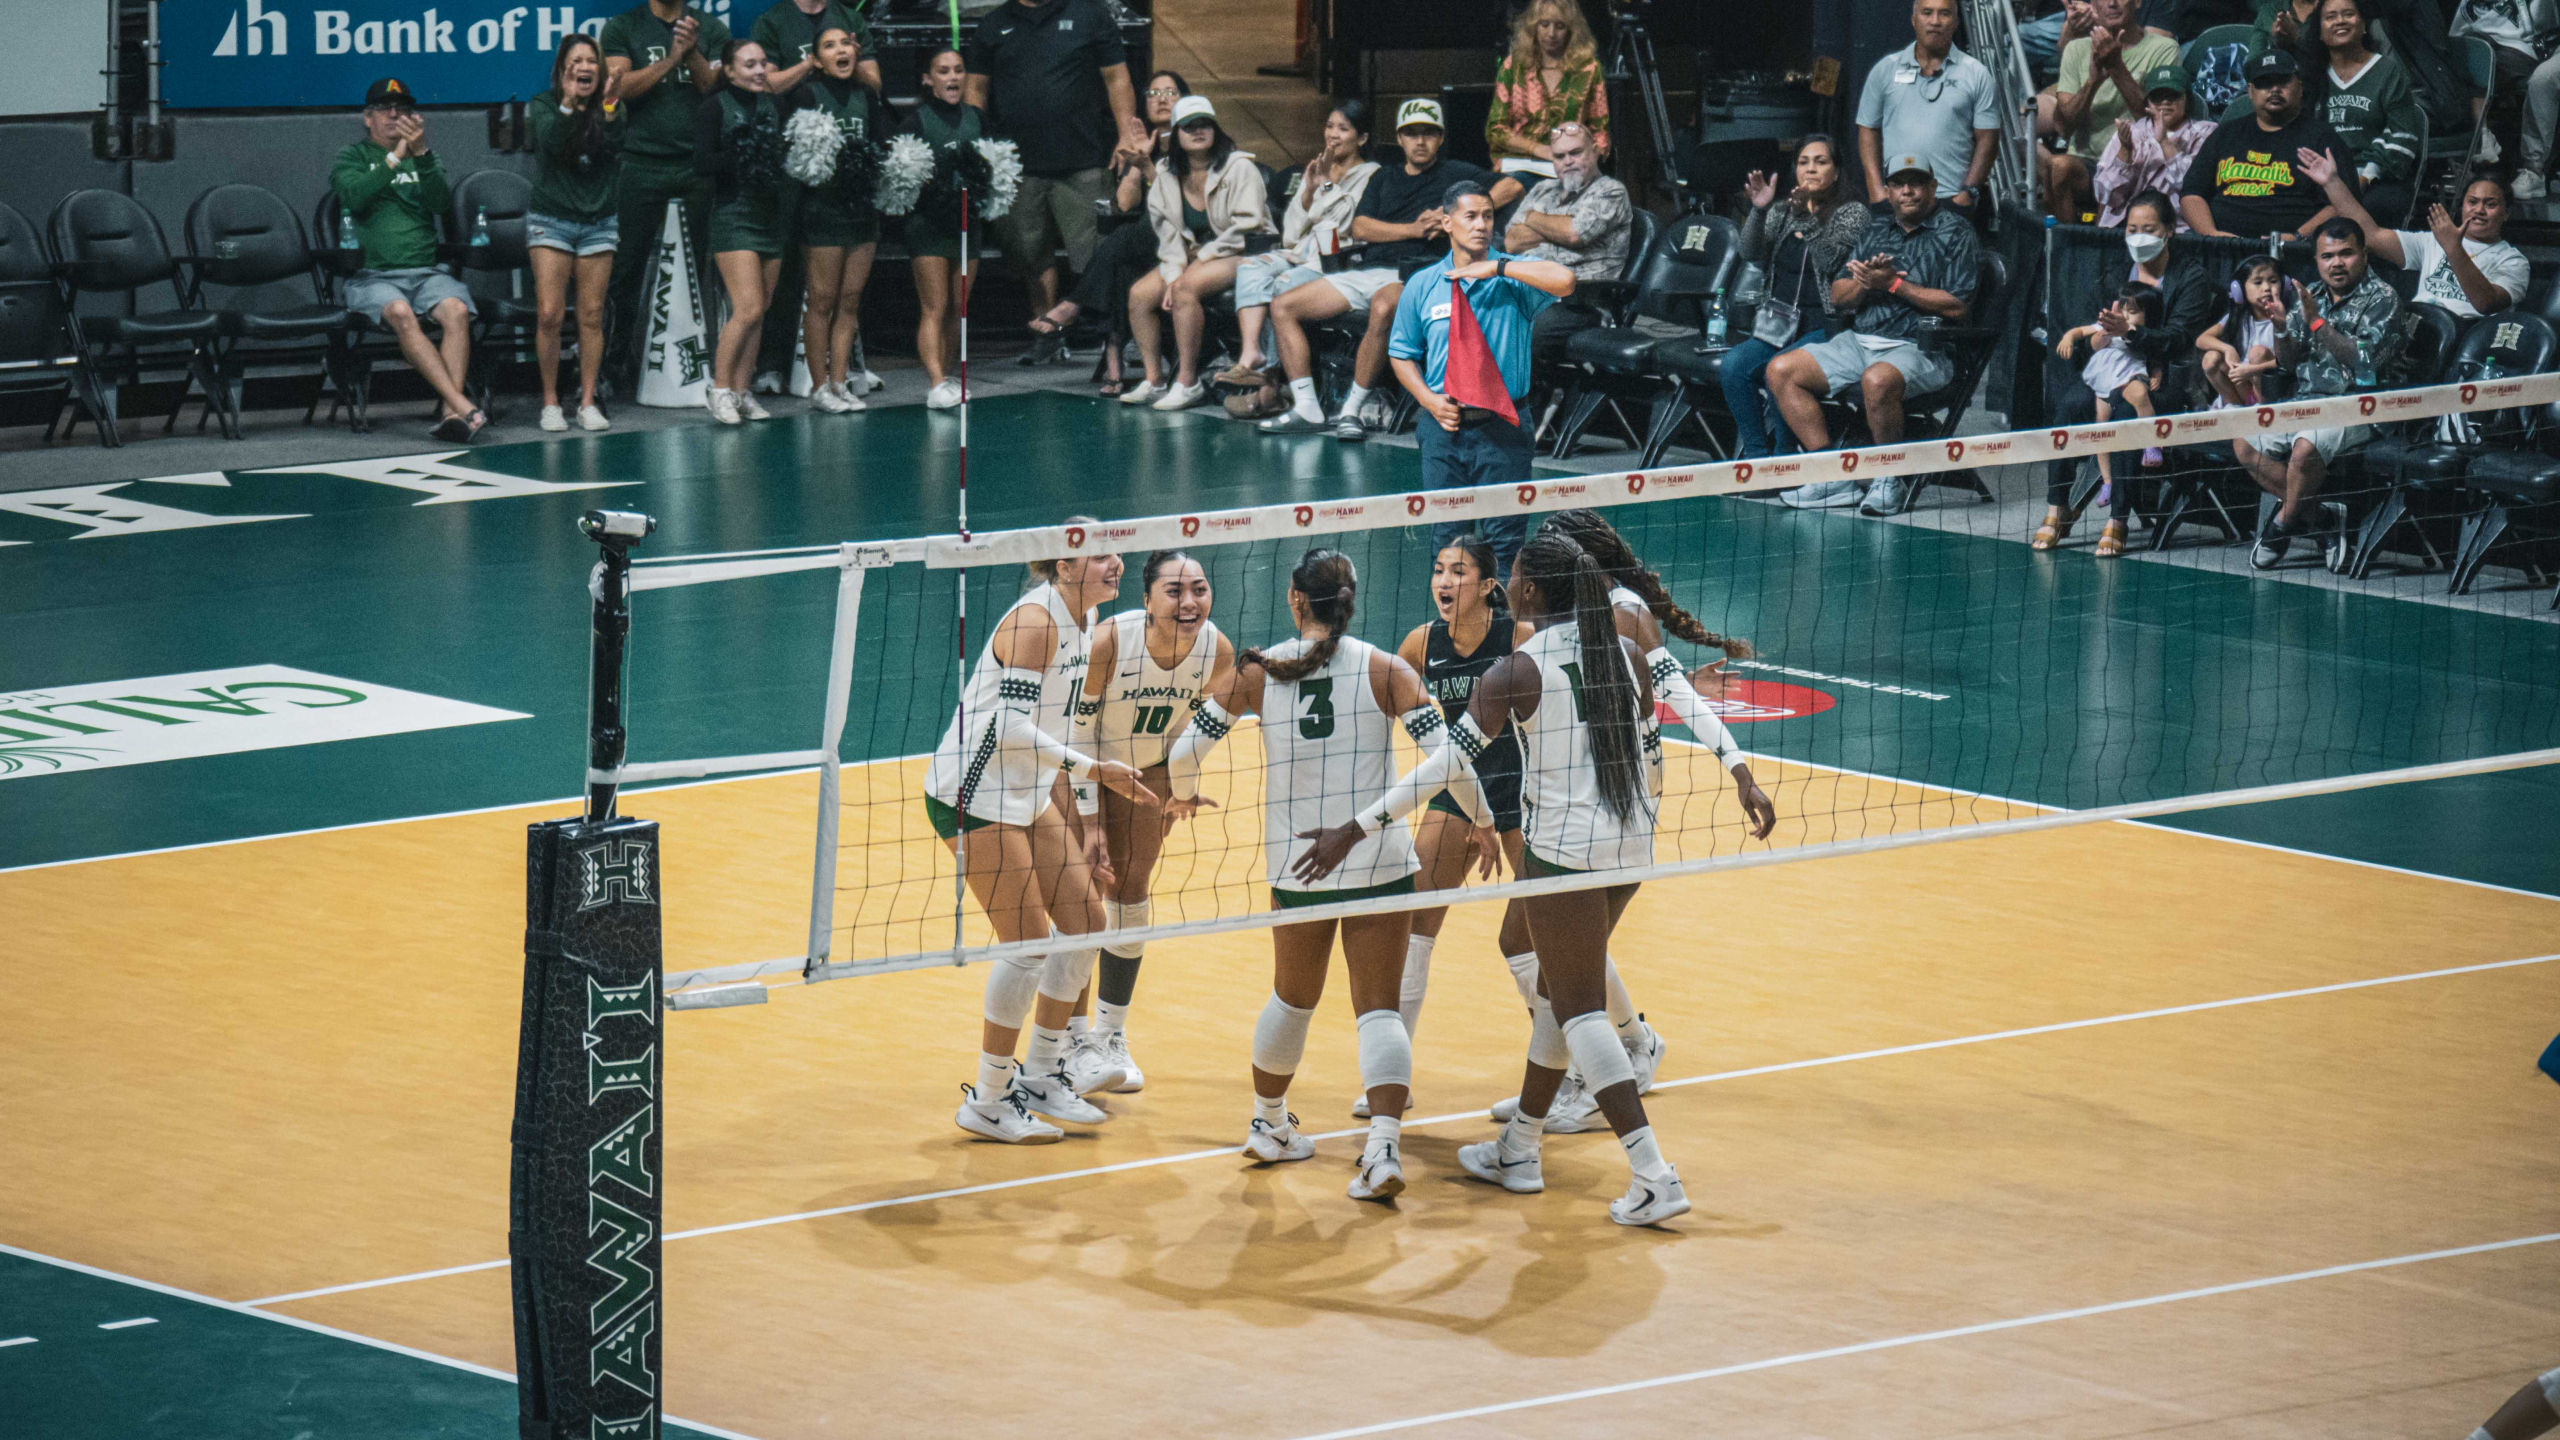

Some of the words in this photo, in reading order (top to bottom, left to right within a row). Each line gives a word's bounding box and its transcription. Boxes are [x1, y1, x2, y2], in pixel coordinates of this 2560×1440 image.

[314, 7, 457, 55] Bank
[467, 6, 529, 54] of
[2216, 157, 2295, 187] Hawaii's
[2090, 430, 2116, 439] HAWAII
[1987, 441, 2011, 451] HAWAII
[1880, 452, 1906, 462] HAWAII
[1774, 463, 1801, 474] HAWAII
[1667, 474, 1693, 484] HAWAII
[1558, 485, 1586, 495] HAWAII
[1449, 495, 1475, 506] HAWAII
[1336, 506, 1364, 516] HAWAII
[1224, 516, 1252, 527] HAWAII
[1109, 528, 1137, 538] HAWAII
[1299, 677, 1335, 740] 3
[1132, 705, 1174, 735] 10
